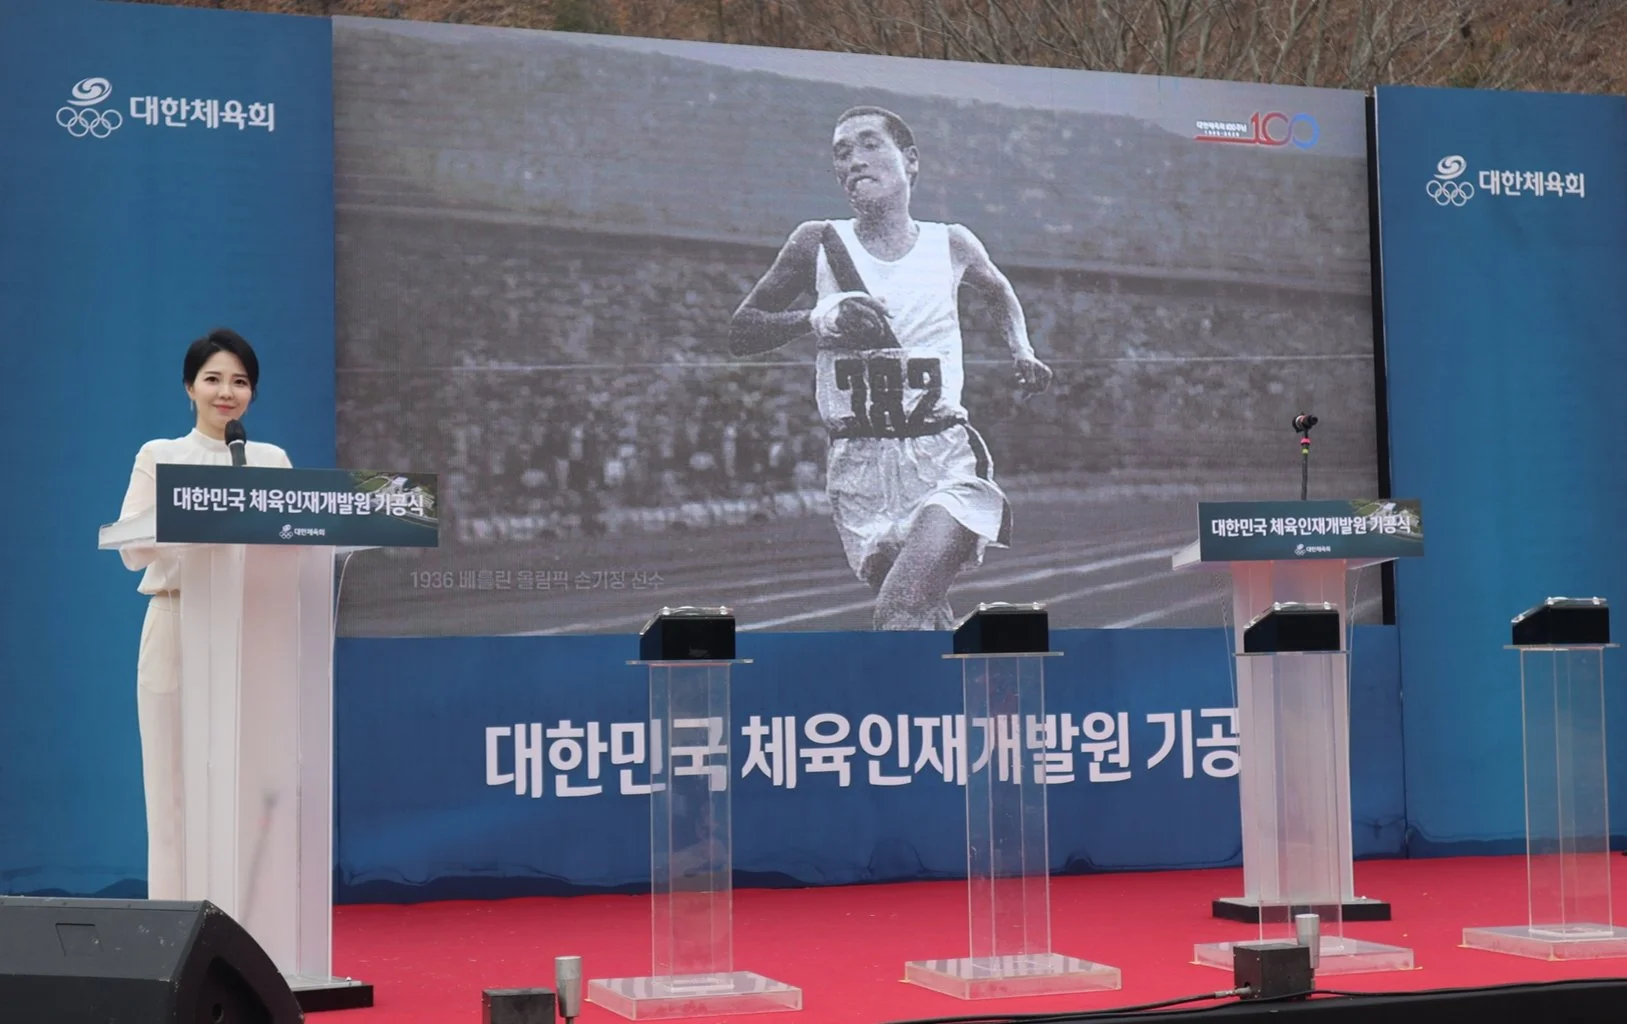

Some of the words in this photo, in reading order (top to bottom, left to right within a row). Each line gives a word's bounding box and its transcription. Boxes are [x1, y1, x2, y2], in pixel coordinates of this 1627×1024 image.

[129, 95, 275, 132] 대한체육회
[1479, 170, 1585, 198] 대한체육회
[173, 487, 246, 511] 대한민국
[249, 489, 371, 515] 체육인재개발원
[374, 493, 425, 516] 기공식
[1211, 518, 1268, 537] 대한민국
[1270, 517, 1367, 536] 체육인재개발원
[1370, 516, 1412, 534] 기공식
[410, 571, 454, 589] 1936
[458, 570, 512, 590] 베를린
[517, 570, 568, 591] 올림픽
[574, 570, 626, 590] 손기정
[631, 570, 665, 590] 선수
[485, 717, 728, 799] 대한민국
[741, 711, 1132, 789] 체육인재개발원
[1146, 707, 1242, 779] 기공
